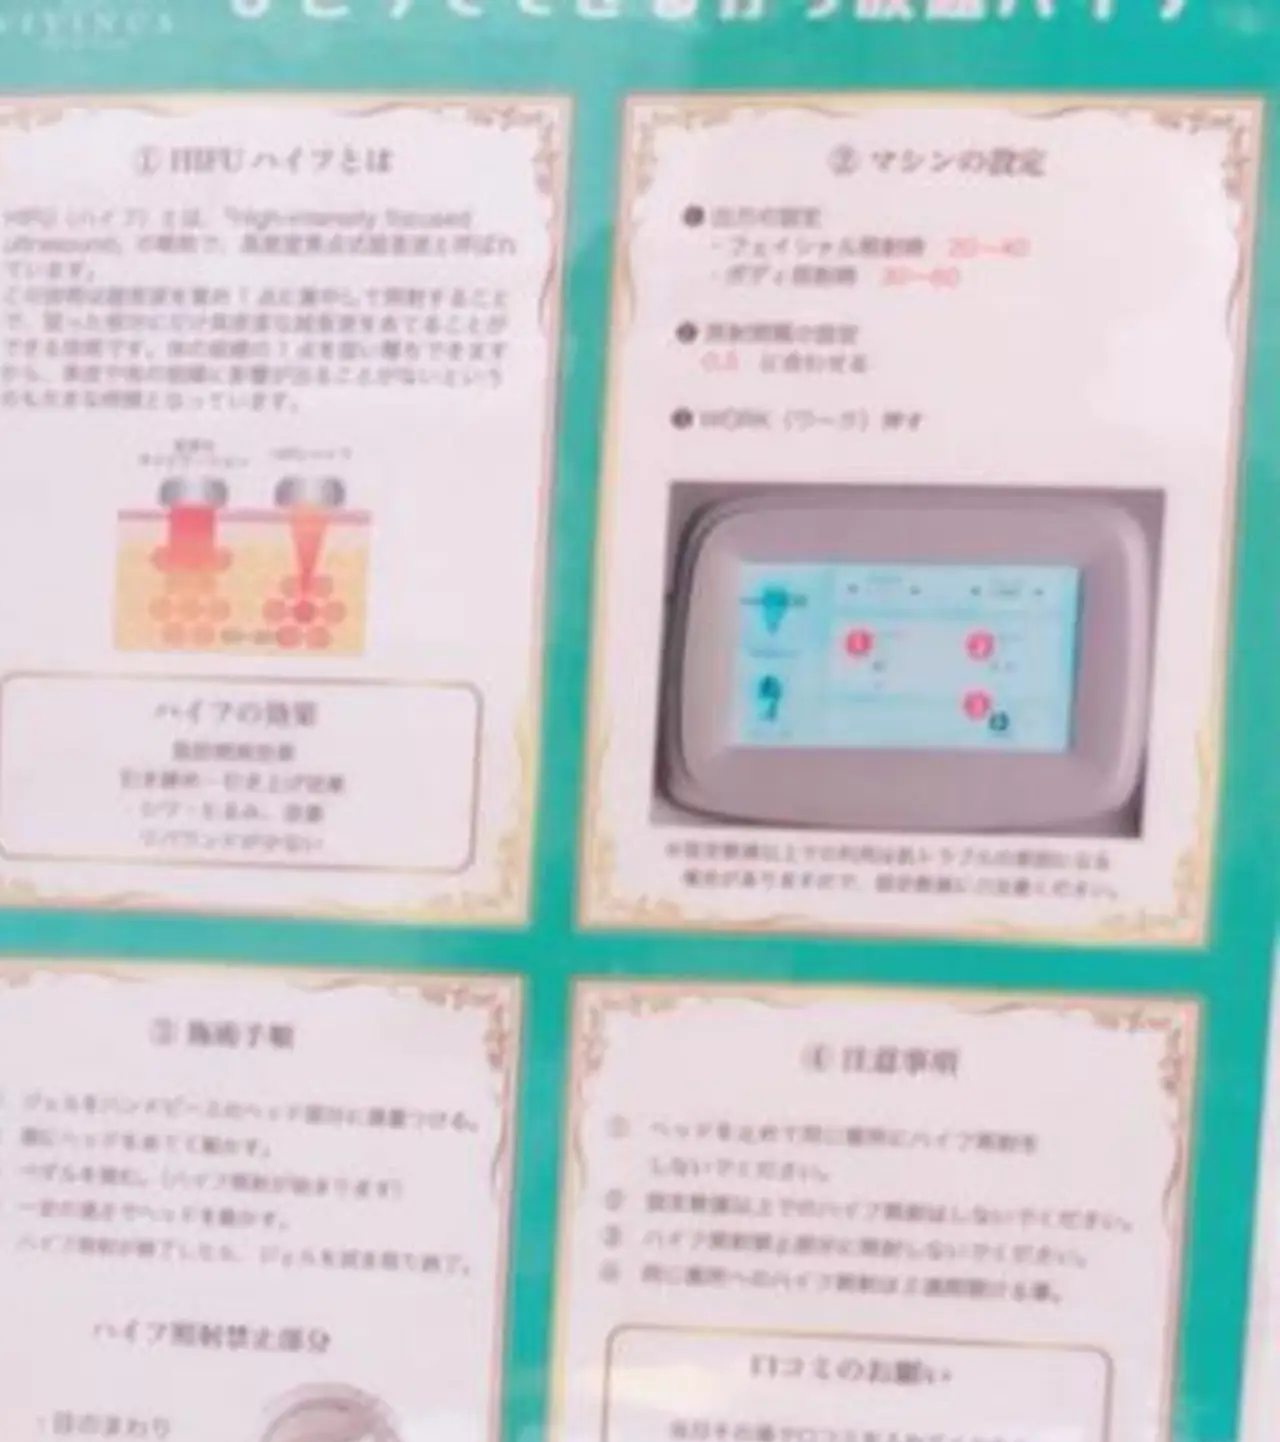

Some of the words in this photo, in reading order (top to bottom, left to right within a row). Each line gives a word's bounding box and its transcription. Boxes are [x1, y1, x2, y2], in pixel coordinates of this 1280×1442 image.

[868, 148, 1047, 178] マシンの設定
[749, 1353, 954, 1386] 口コミのお願い
